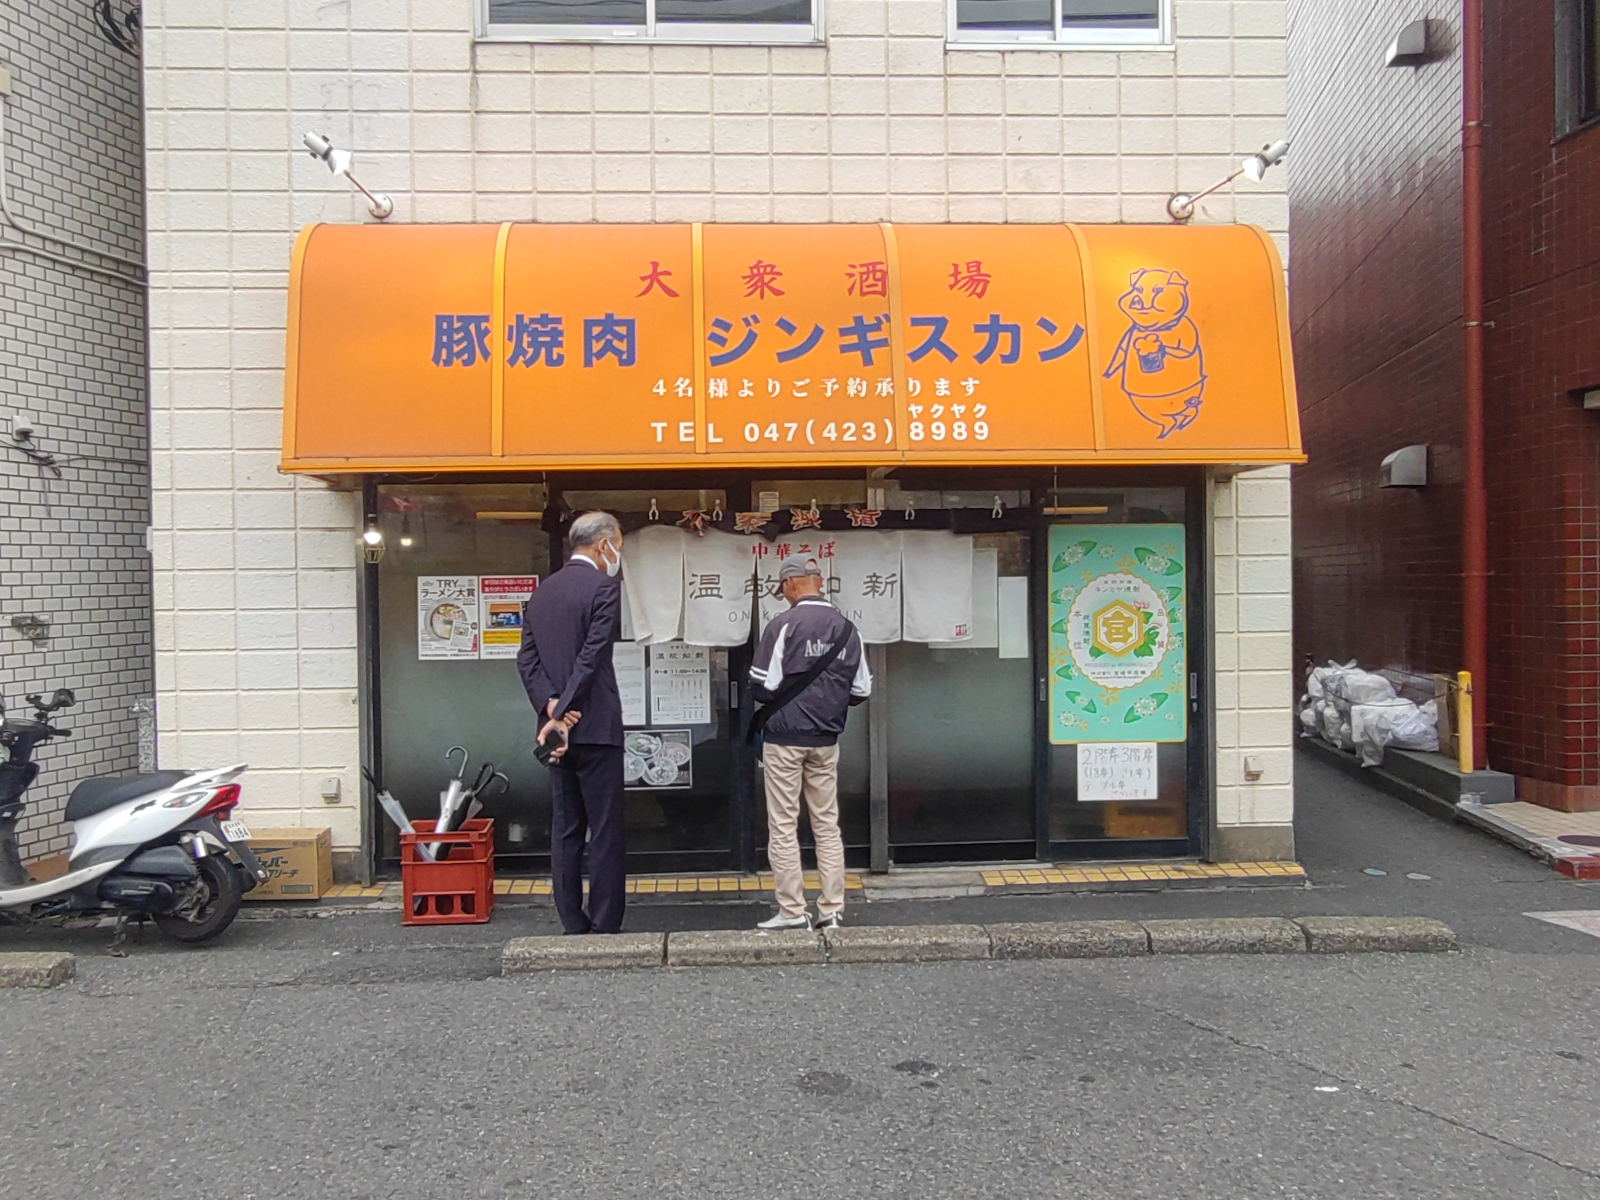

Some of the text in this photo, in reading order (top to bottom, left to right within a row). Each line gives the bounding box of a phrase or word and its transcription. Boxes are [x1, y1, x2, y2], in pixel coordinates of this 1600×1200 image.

[635, 259, 991, 300] 大衆酒場
[431, 312, 1085, 368] 豚焼肉 ジンギスカン
[908, 403, 987, 419] ヤクヤク
[650, 422, 723, 443] TEL
[437, 579, 459, 588] TRY
[420, 588, 477, 598] ラーメン大賞
